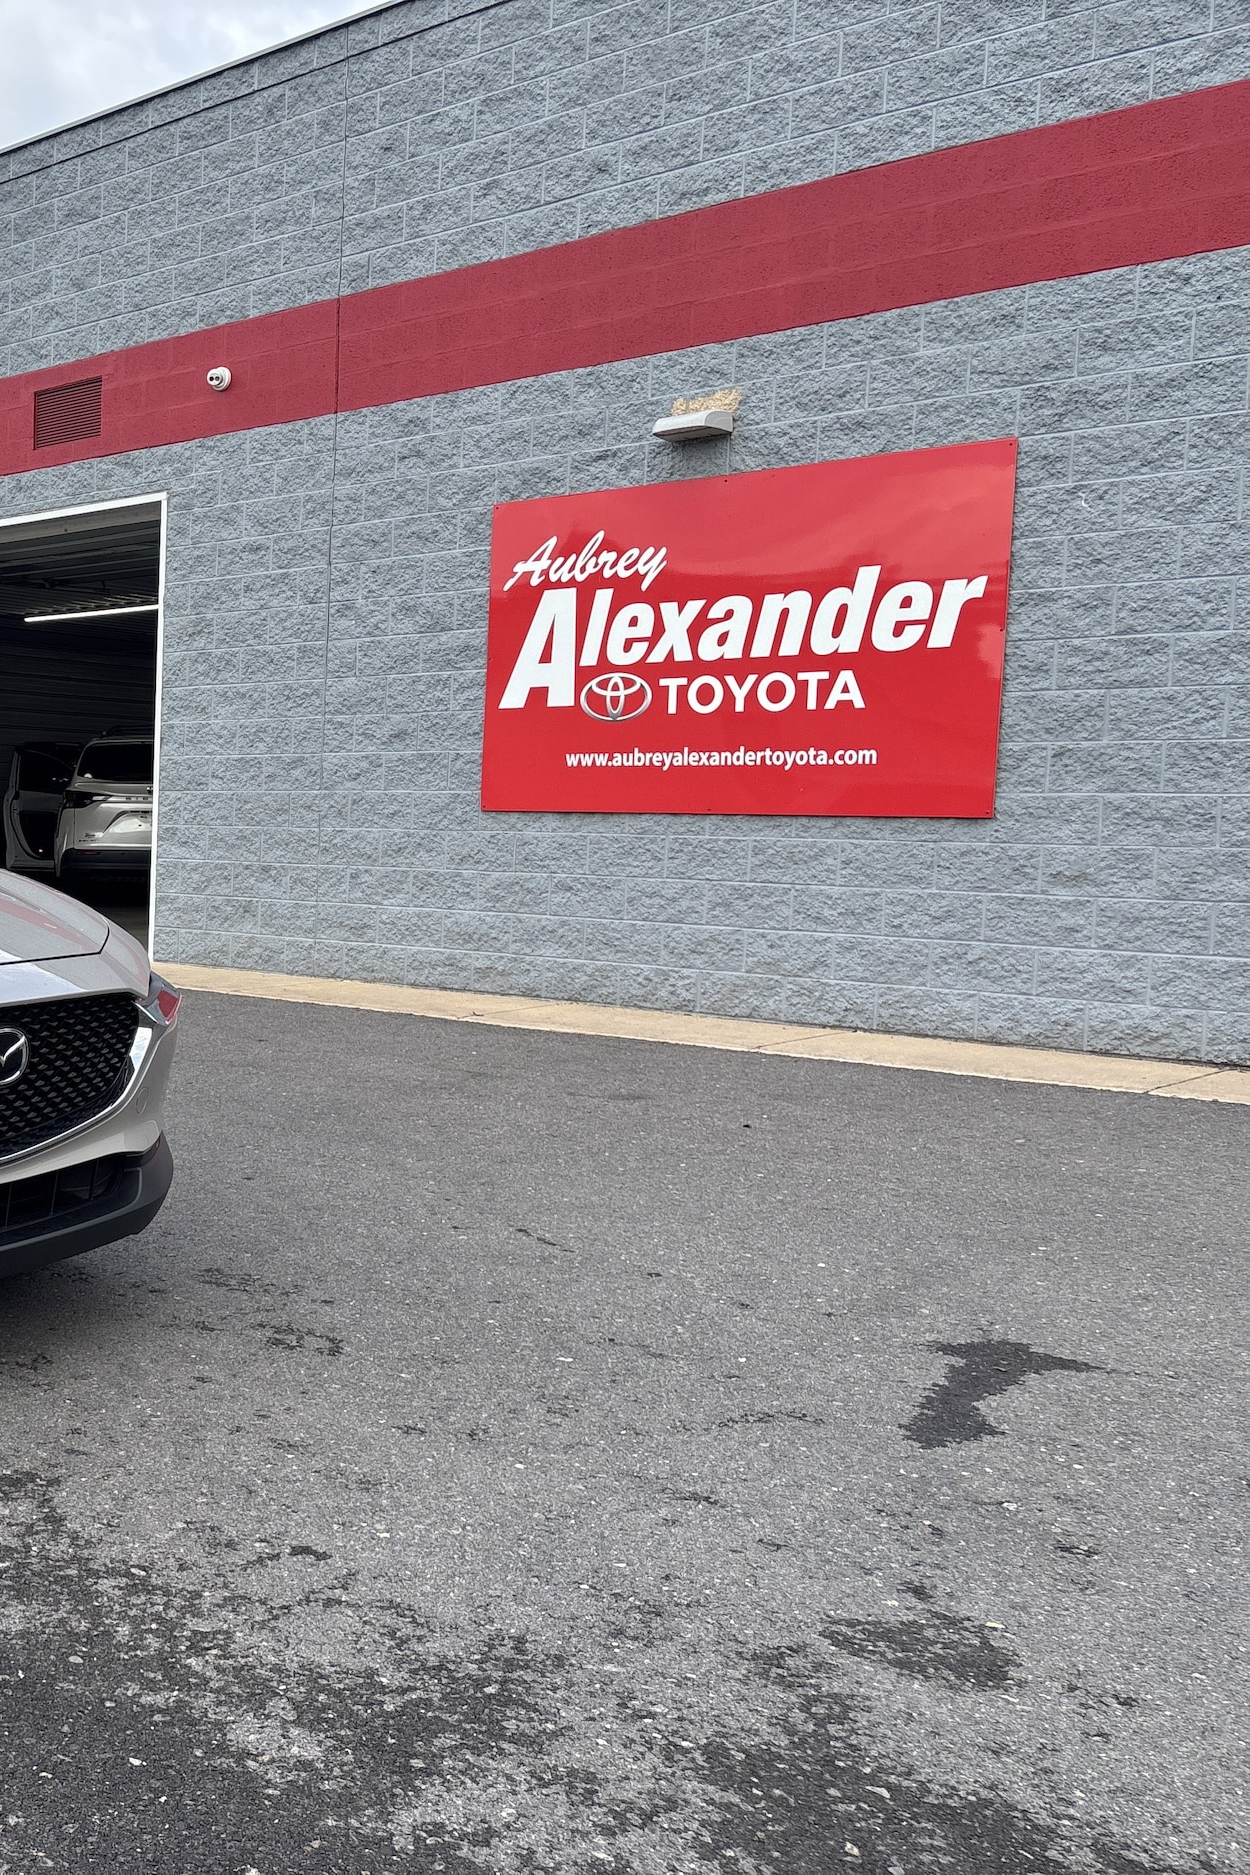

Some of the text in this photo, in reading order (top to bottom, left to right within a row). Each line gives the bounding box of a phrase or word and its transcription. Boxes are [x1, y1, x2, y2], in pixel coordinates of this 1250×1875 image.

[503, 530, 667, 591] Aubrey
[498, 565, 989, 710] Alexander
[659, 670, 866, 715] TOYOTA
[565, 745, 878, 771] www.aubreyalexandertoyota.com
